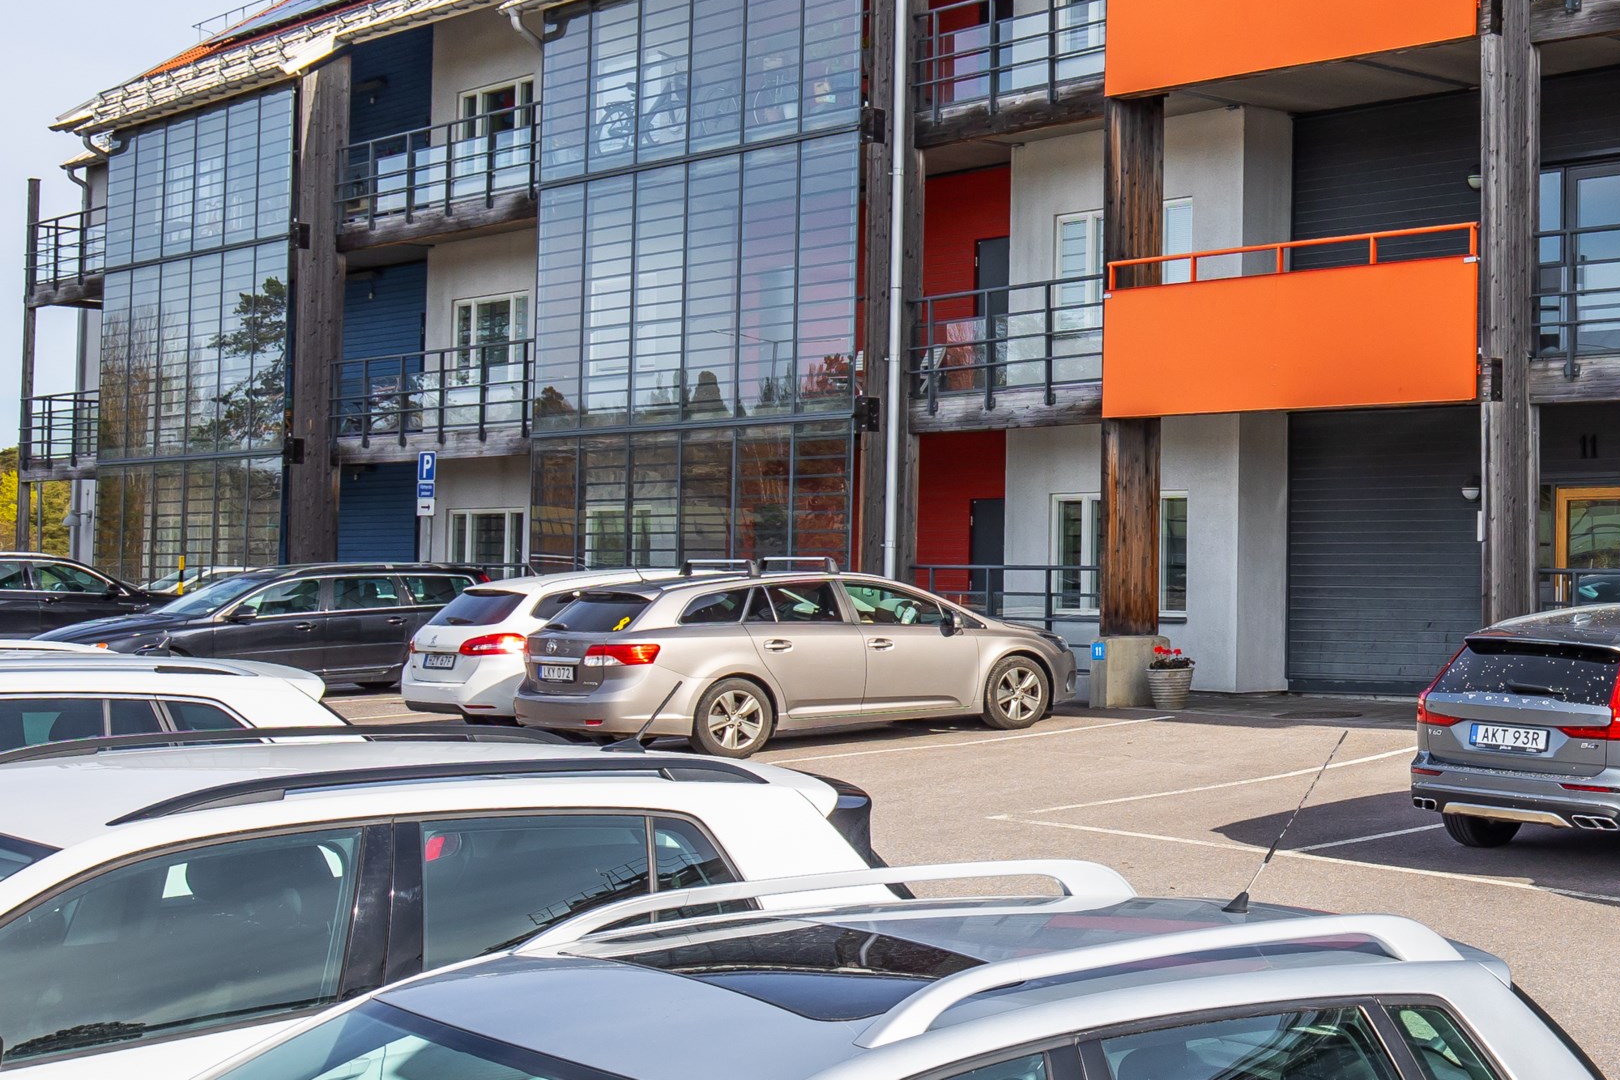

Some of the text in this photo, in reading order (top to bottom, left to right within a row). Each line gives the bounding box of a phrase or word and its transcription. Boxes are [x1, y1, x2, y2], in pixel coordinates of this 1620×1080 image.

[1579, 433, 1598, 459] 11
[422, 454, 433, 479] P
[1095, 646, 1102, 657] 11
[543, 666, 571, 679] LKY 072
[1481, 727, 1540, 747] AKT 93R
